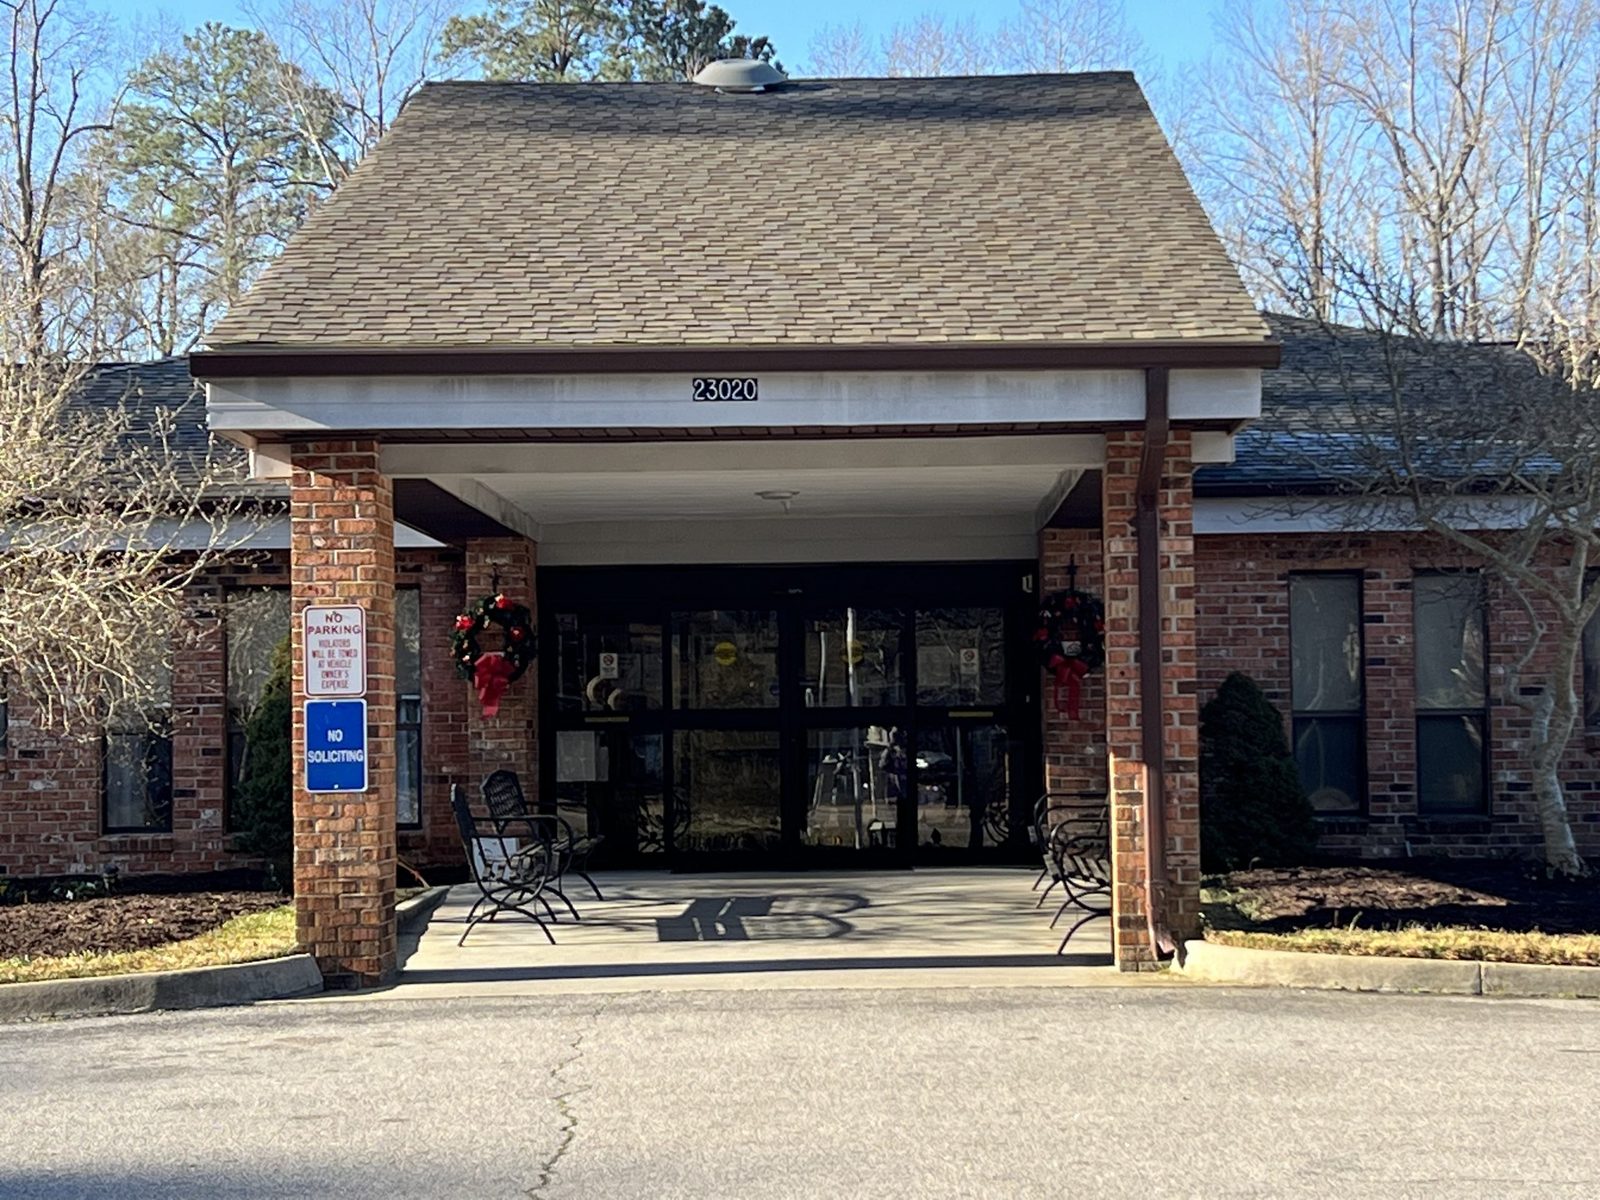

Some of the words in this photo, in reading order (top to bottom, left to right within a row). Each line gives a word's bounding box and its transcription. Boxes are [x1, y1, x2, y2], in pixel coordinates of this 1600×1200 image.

[694, 379, 757, 400] 23020
[325, 613, 343, 623] NO
[307, 625, 362, 635] PARKING
[312, 649, 325, 659] WILL
[327, 649, 336, 658] BE
[338, 649, 358, 658] TOWED
[321, 680, 349, 689] EXPENSE
[327, 729, 344, 742] NO
[307, 749, 364, 763] SOLICITING
